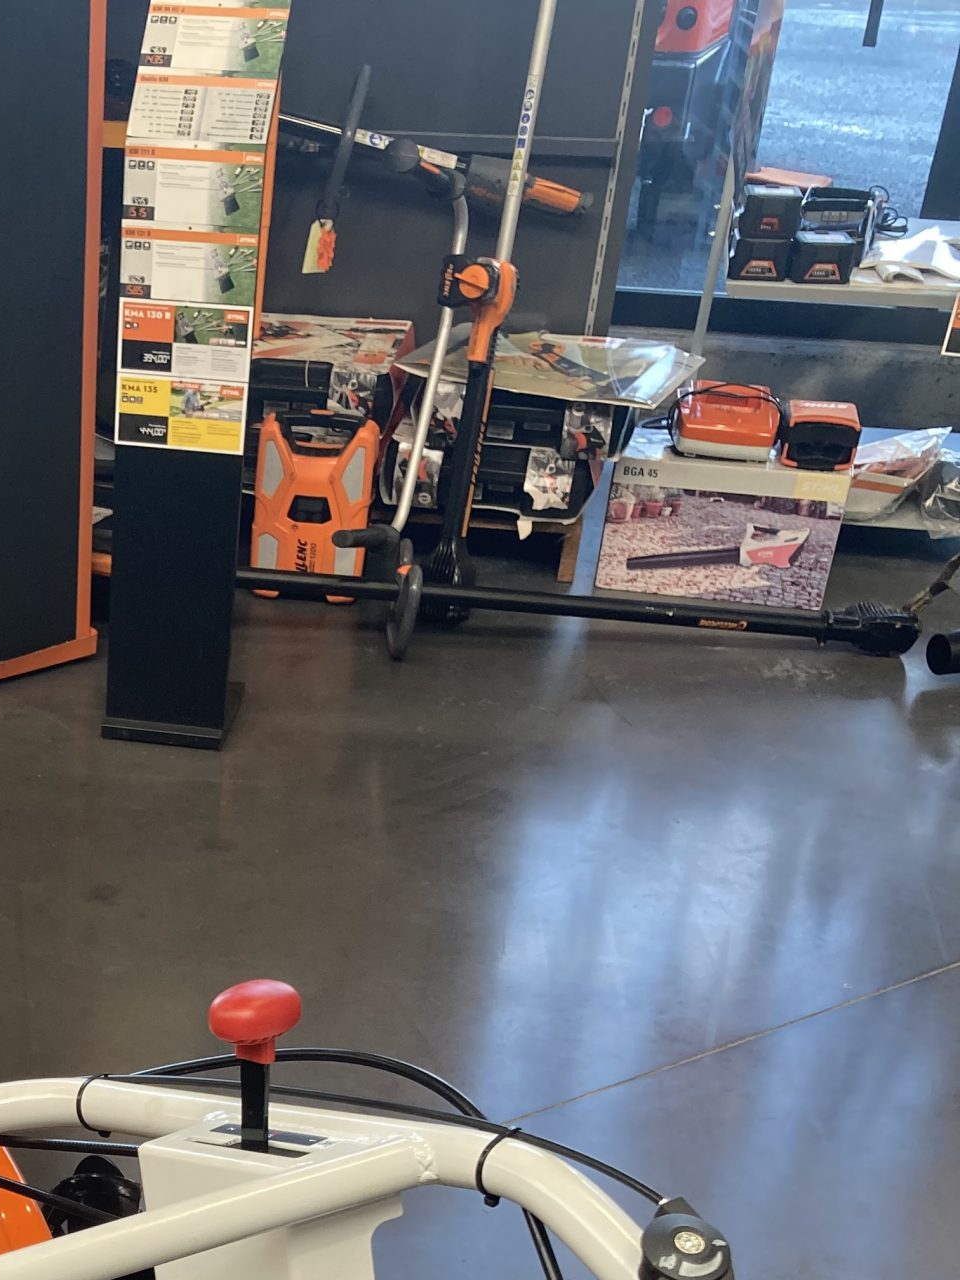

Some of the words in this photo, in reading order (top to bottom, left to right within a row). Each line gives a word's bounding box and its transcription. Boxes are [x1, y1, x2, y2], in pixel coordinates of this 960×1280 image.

[125, 309, 144, 318] KMA
[147, 310, 163, 320] 130
[164, 311, 172, 320] R
[121, 383, 141, 392] KMA
[143, 384, 158, 394] 135
[623, 466, 644, 477] BGA
[647, 469, 659, 479] 45
[800, 482, 841, 493] STIHL
